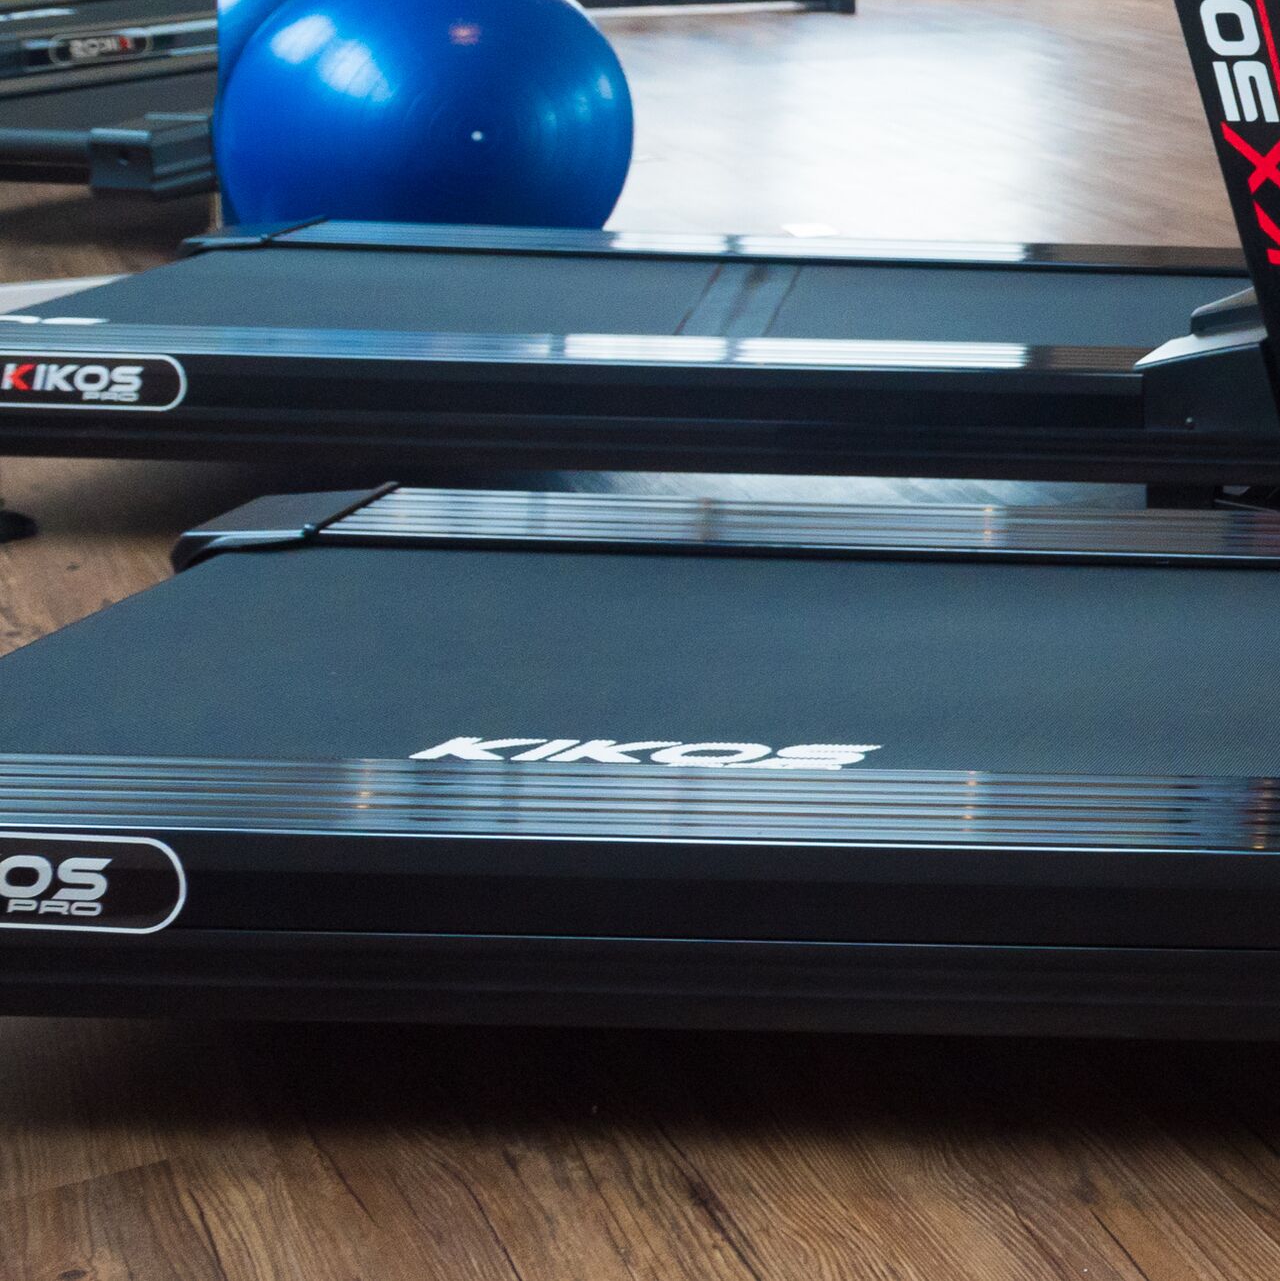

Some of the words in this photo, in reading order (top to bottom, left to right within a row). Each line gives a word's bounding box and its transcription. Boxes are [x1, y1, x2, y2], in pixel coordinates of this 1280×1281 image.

[1, 363, 144, 393] KIKOS
[81, 391, 140, 402] PRO
[409, 736, 882, 765] KIKOS
[0, 854, 113, 901] OS
[7, 898, 103, 917] PRO
